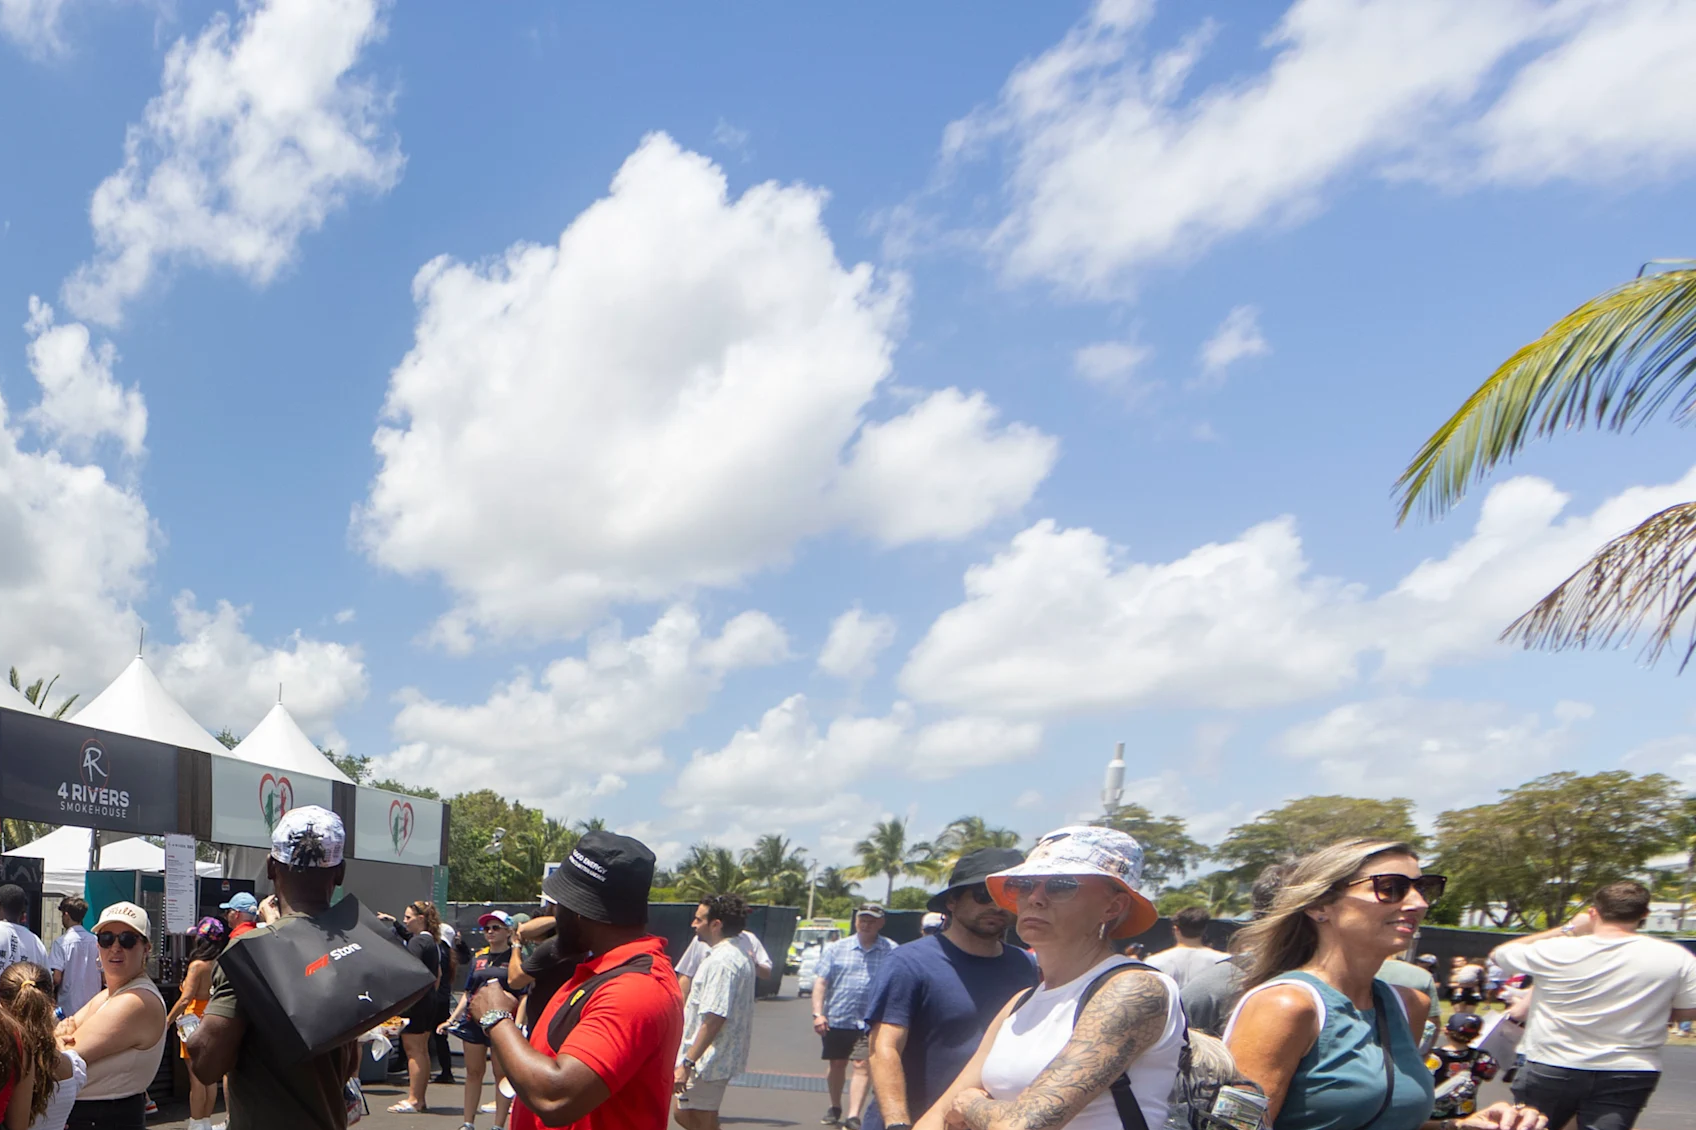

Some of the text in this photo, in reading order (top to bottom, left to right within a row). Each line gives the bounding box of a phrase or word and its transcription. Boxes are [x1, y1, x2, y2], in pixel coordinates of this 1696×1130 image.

[57, 781, 130, 808] 4 RIVERS
[60, 801, 127, 818] SMOKEHOUSE
[329, 943, 362, 960] Store
